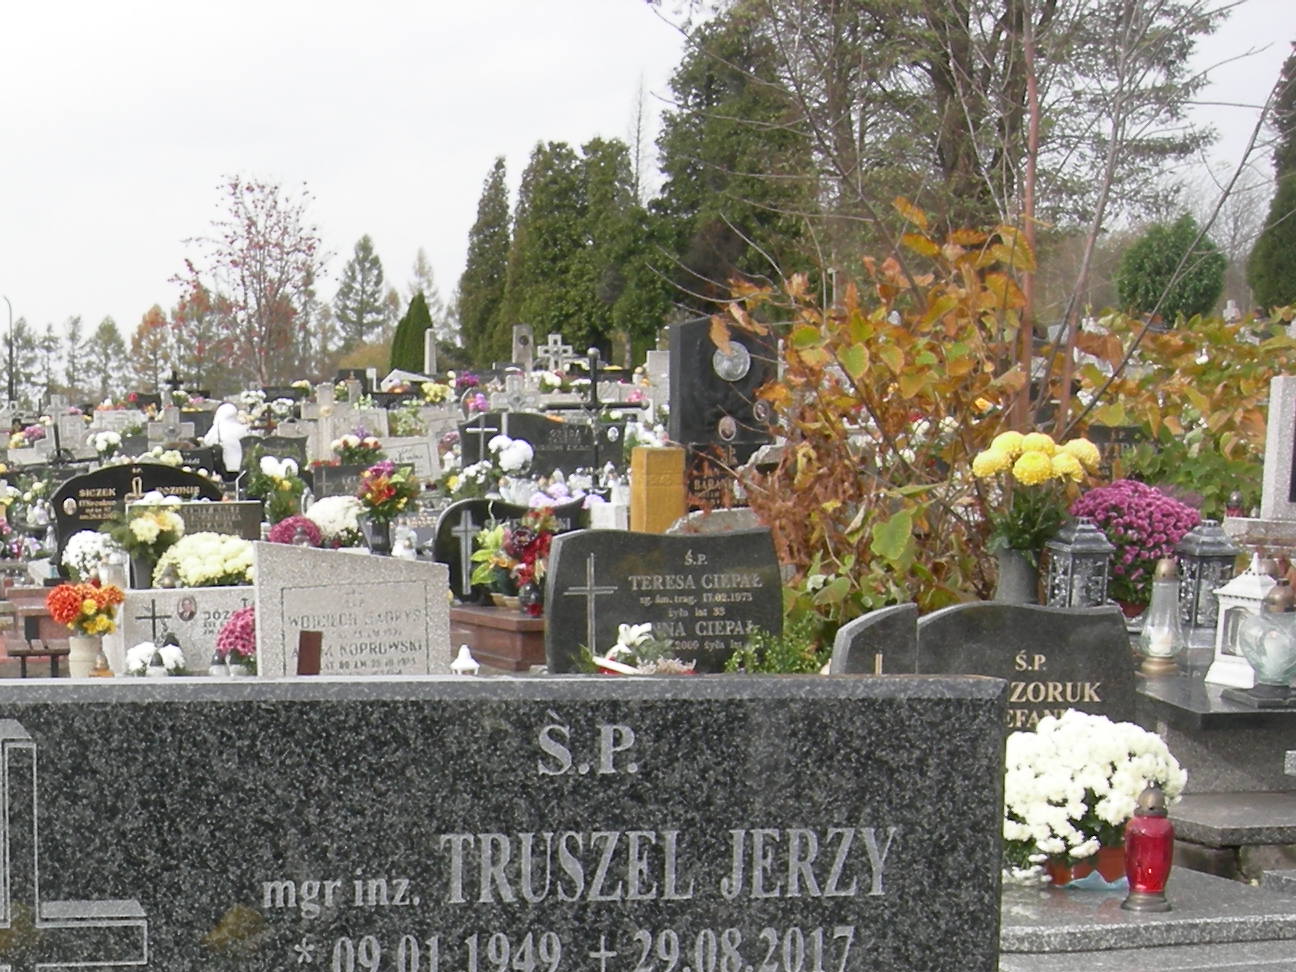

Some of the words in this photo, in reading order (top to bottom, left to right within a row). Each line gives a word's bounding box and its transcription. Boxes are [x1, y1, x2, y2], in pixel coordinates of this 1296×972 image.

[628, 575, 696, 592] TERESA
[701, 573, 763, 589] CIEPAŁ
[1009, 681, 1102, 703] ZORUK
[262, 879, 342, 918] mgr
[440, 830, 694, 903] TRUSZEL
[720, 827, 897, 900] JERZY
